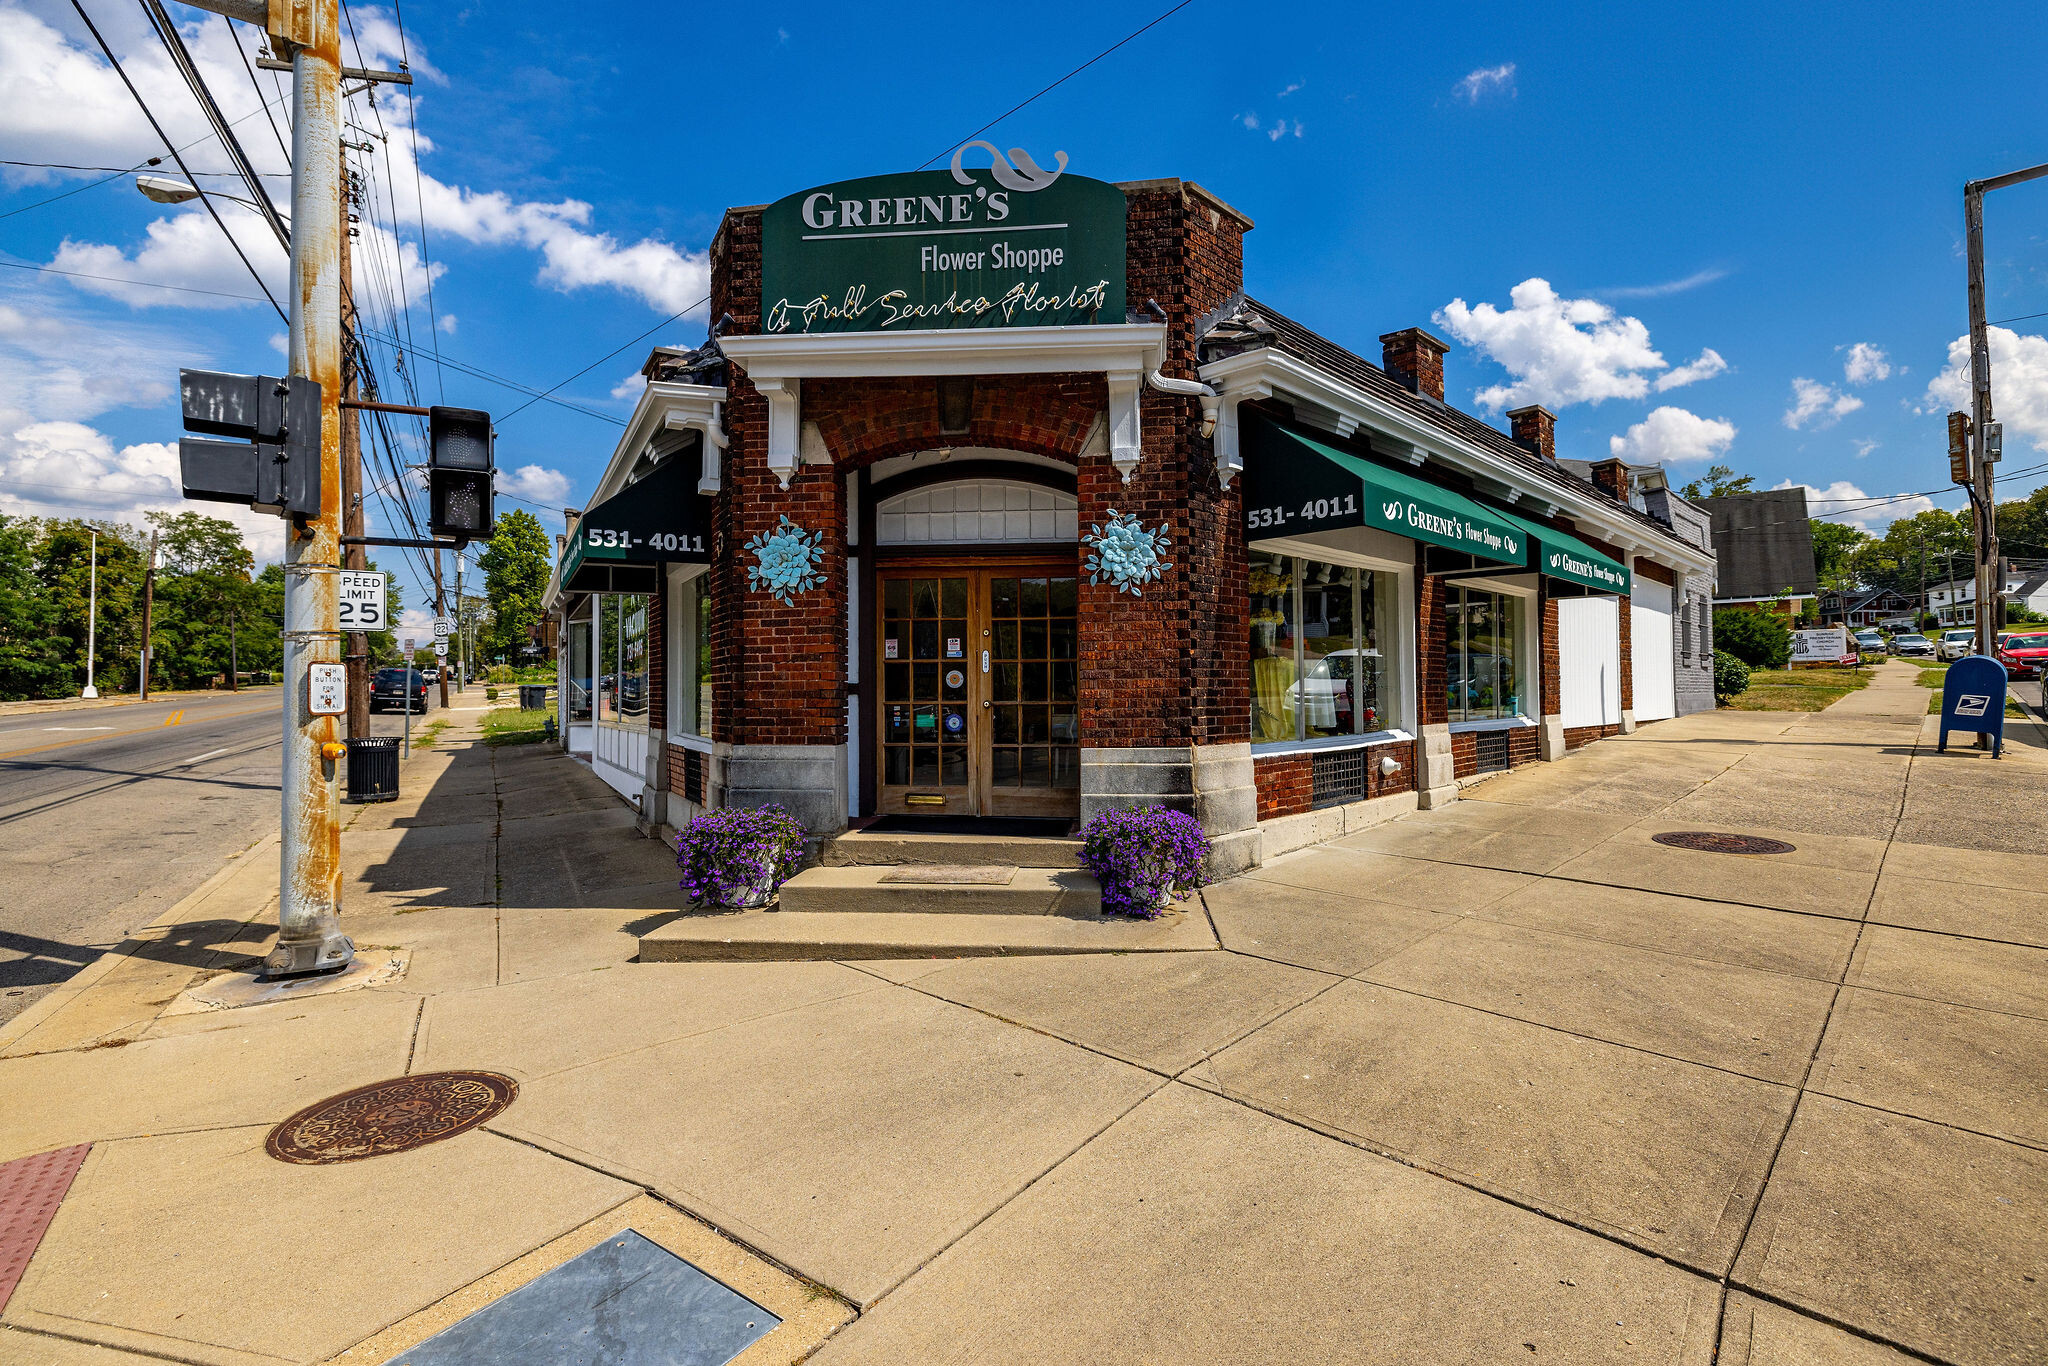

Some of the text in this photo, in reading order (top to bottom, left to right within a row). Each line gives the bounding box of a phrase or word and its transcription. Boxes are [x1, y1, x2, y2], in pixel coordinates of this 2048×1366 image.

[802, 187, 1010, 229] GREENE'S
[921, 242, 1064, 273] Flower Shoppe
[803, 284, 867, 333] Full
[879, 289, 988, 327] Service
[1001, 280, 1109, 323] Florist
[1301, 494, 1357, 520] 4011
[1407, 503, 1501, 550] GREENE'S Flower Shoppe
[648, 533, 705, 553] 4011
[1562, 553, 1592, 578] GREENE'S
[340, 577, 381, 587] PEED
[340, 602, 379, 623] 25
[436, 625, 446, 633] 22
